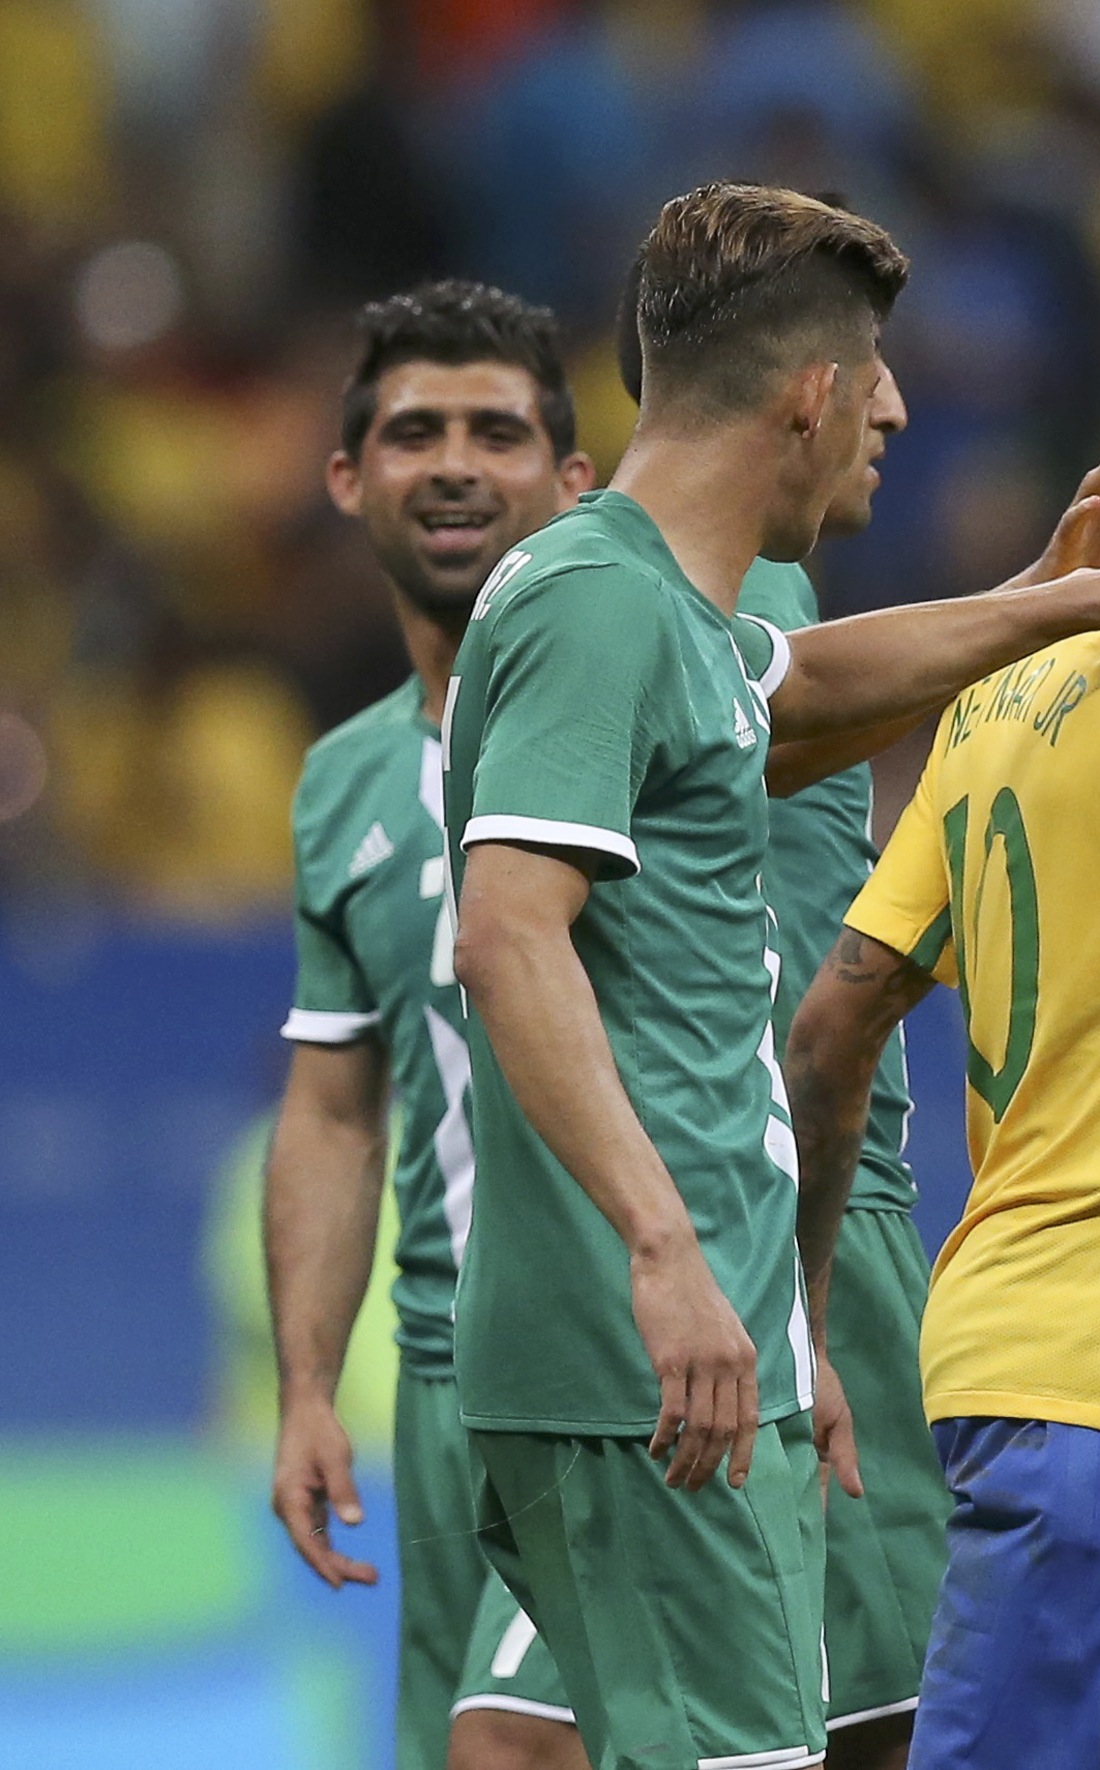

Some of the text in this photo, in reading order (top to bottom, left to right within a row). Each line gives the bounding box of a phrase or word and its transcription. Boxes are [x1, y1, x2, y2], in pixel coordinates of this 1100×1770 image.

[944, 656, 1088, 759] NEMAR JR
[943, 786, 1039, 1124] 10
